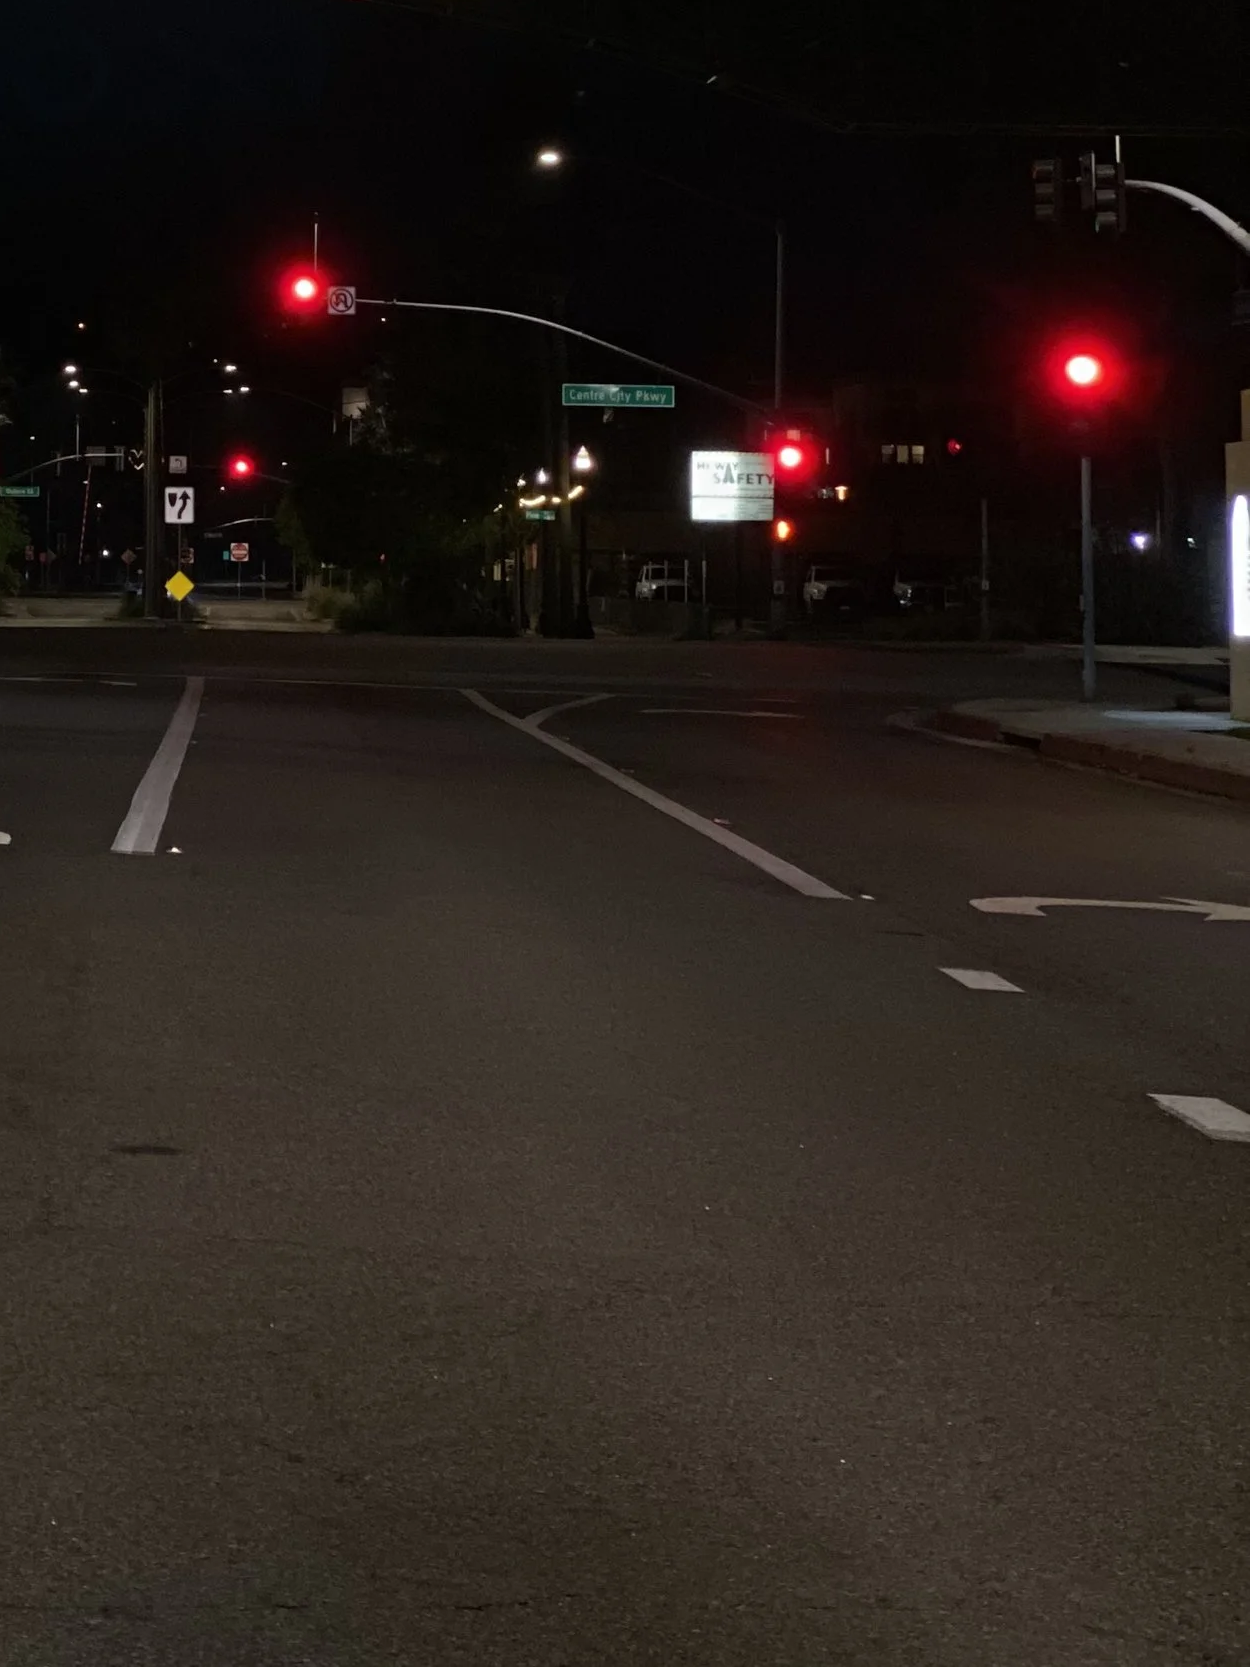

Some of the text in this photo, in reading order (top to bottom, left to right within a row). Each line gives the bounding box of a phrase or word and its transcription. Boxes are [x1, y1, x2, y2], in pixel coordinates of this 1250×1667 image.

[570, 390, 667, 404] Centre City Pkwy
[713, 470, 774, 484] SAFETY
